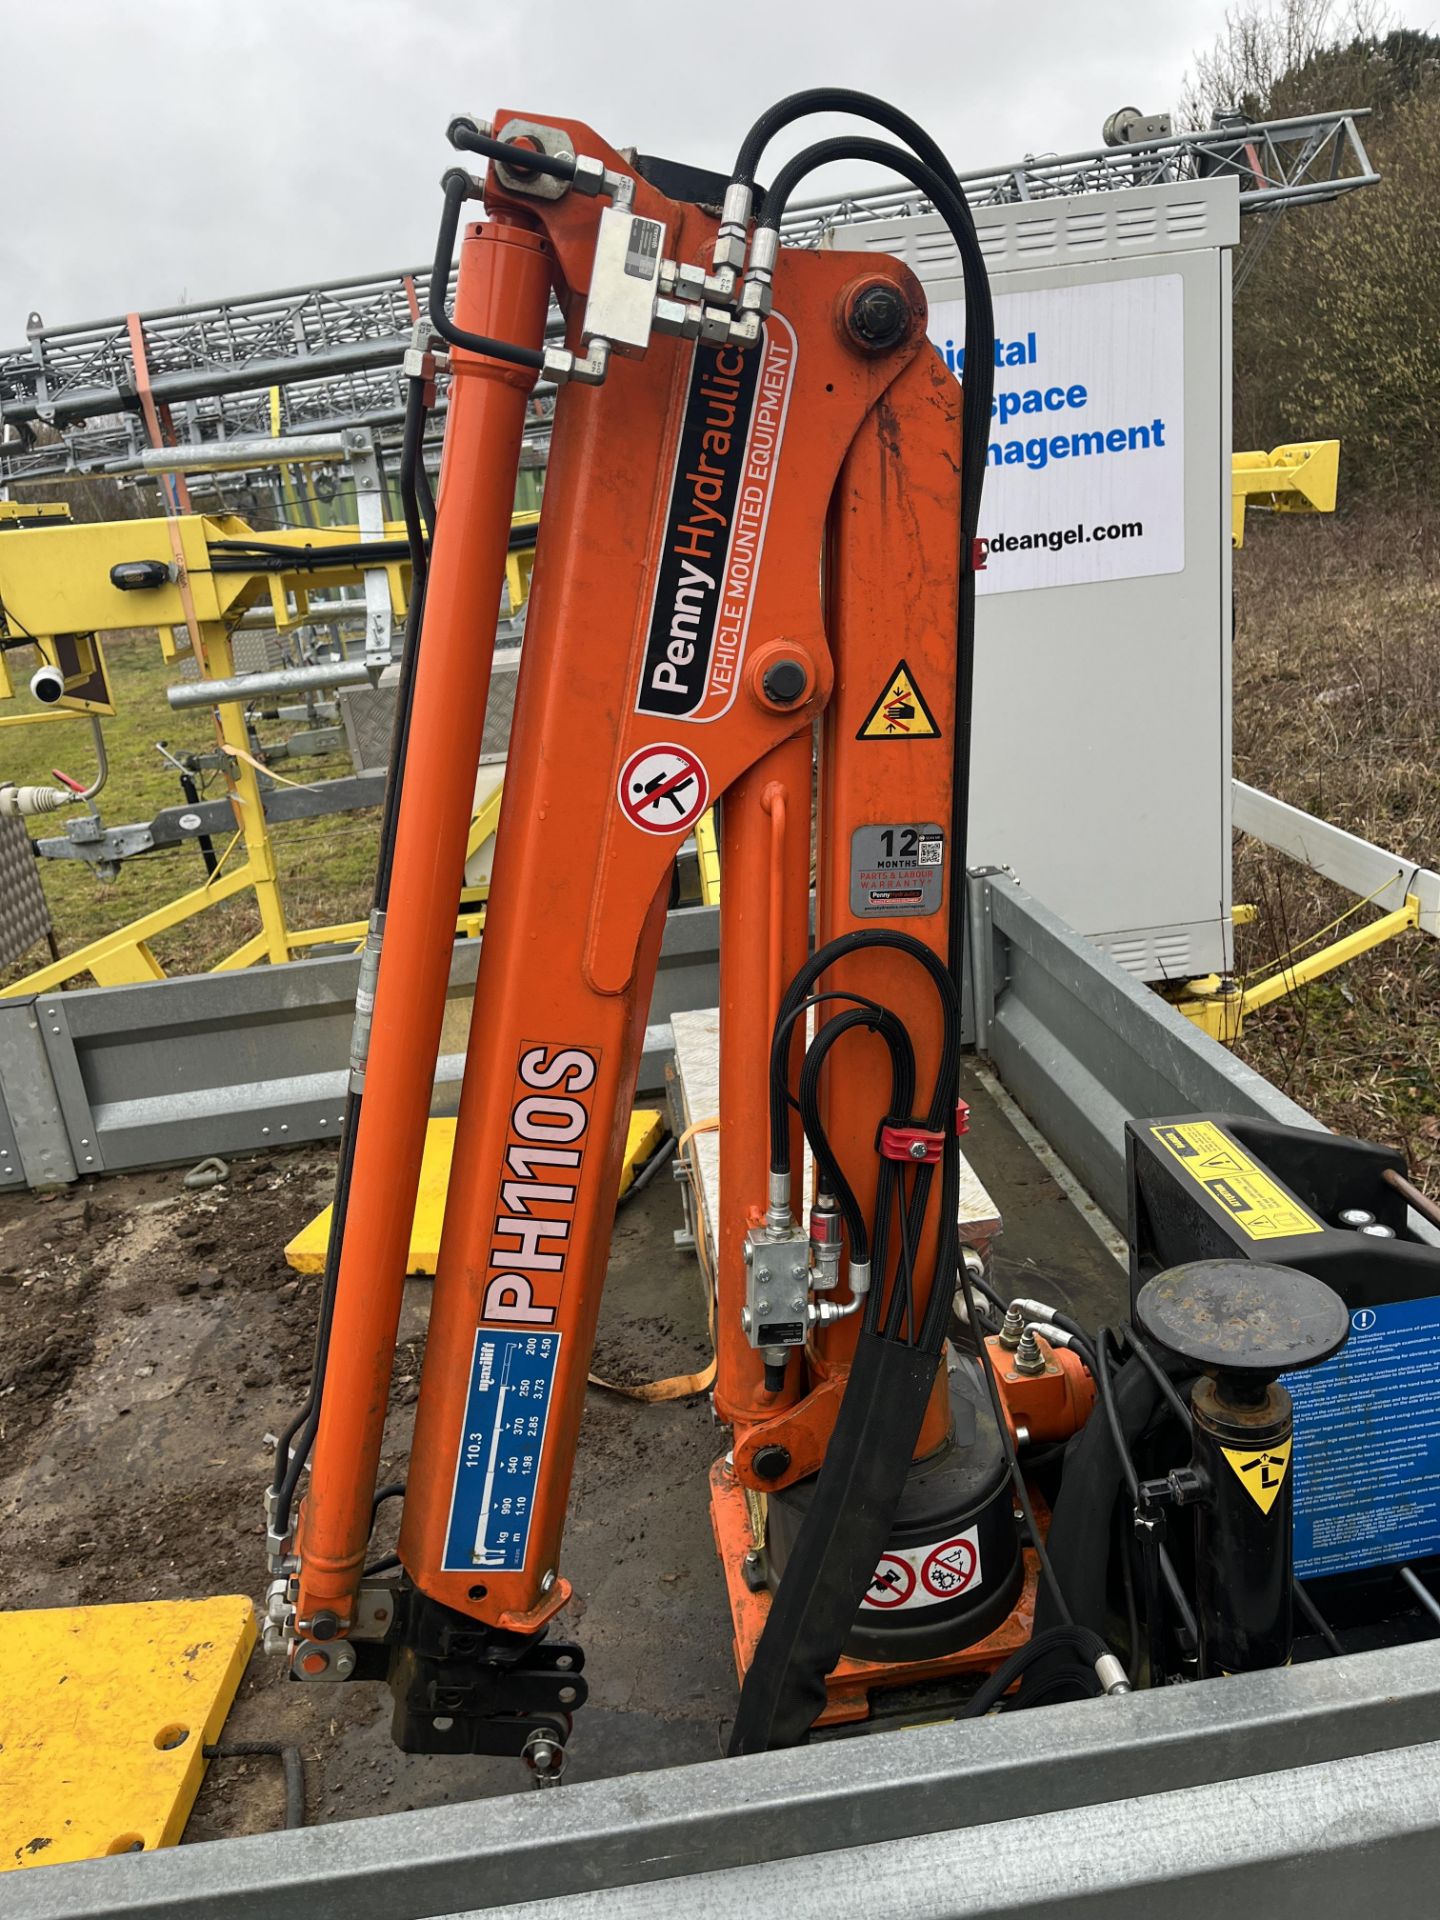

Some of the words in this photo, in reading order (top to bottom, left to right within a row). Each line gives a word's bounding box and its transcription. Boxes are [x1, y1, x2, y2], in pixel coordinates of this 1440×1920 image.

[709, 604, 744, 697] VEHICLE
[727, 487, 764, 591] MOUNTED
[749, 340, 790, 481] EQUIPMENT
[881, 829, 918, 857] 12
[877, 860, 917, 869] MONTHS
[860, 871, 887, 880] PARTS
[890, 871, 896, 880] &
[898, 870, 933, 879] LABOUR
[480, 1047, 597, 1325] PH110S
[526, 1337, 537, 1356] 200
[540, 1338, 552, 1359] 4.50
[478, 1342, 496, 1392] maxilift
[519, 1379, 531, 1397] 250
[533, 1379, 545, 1400] 3.73
[514, 1417, 525, 1436] 370
[528, 1416, 539, 1437] 2.85
[466, 1432, 482, 1468] 110.3
[507, 1456, 519, 1474] 540
[522, 1455, 533, 1475] 1.98
[501, 1497, 513, 1516] 990
[515, 1496, 527, 1516] 1.10
[496, 1531, 509, 1544] kg
[513, 1532, 521, 1542] m
